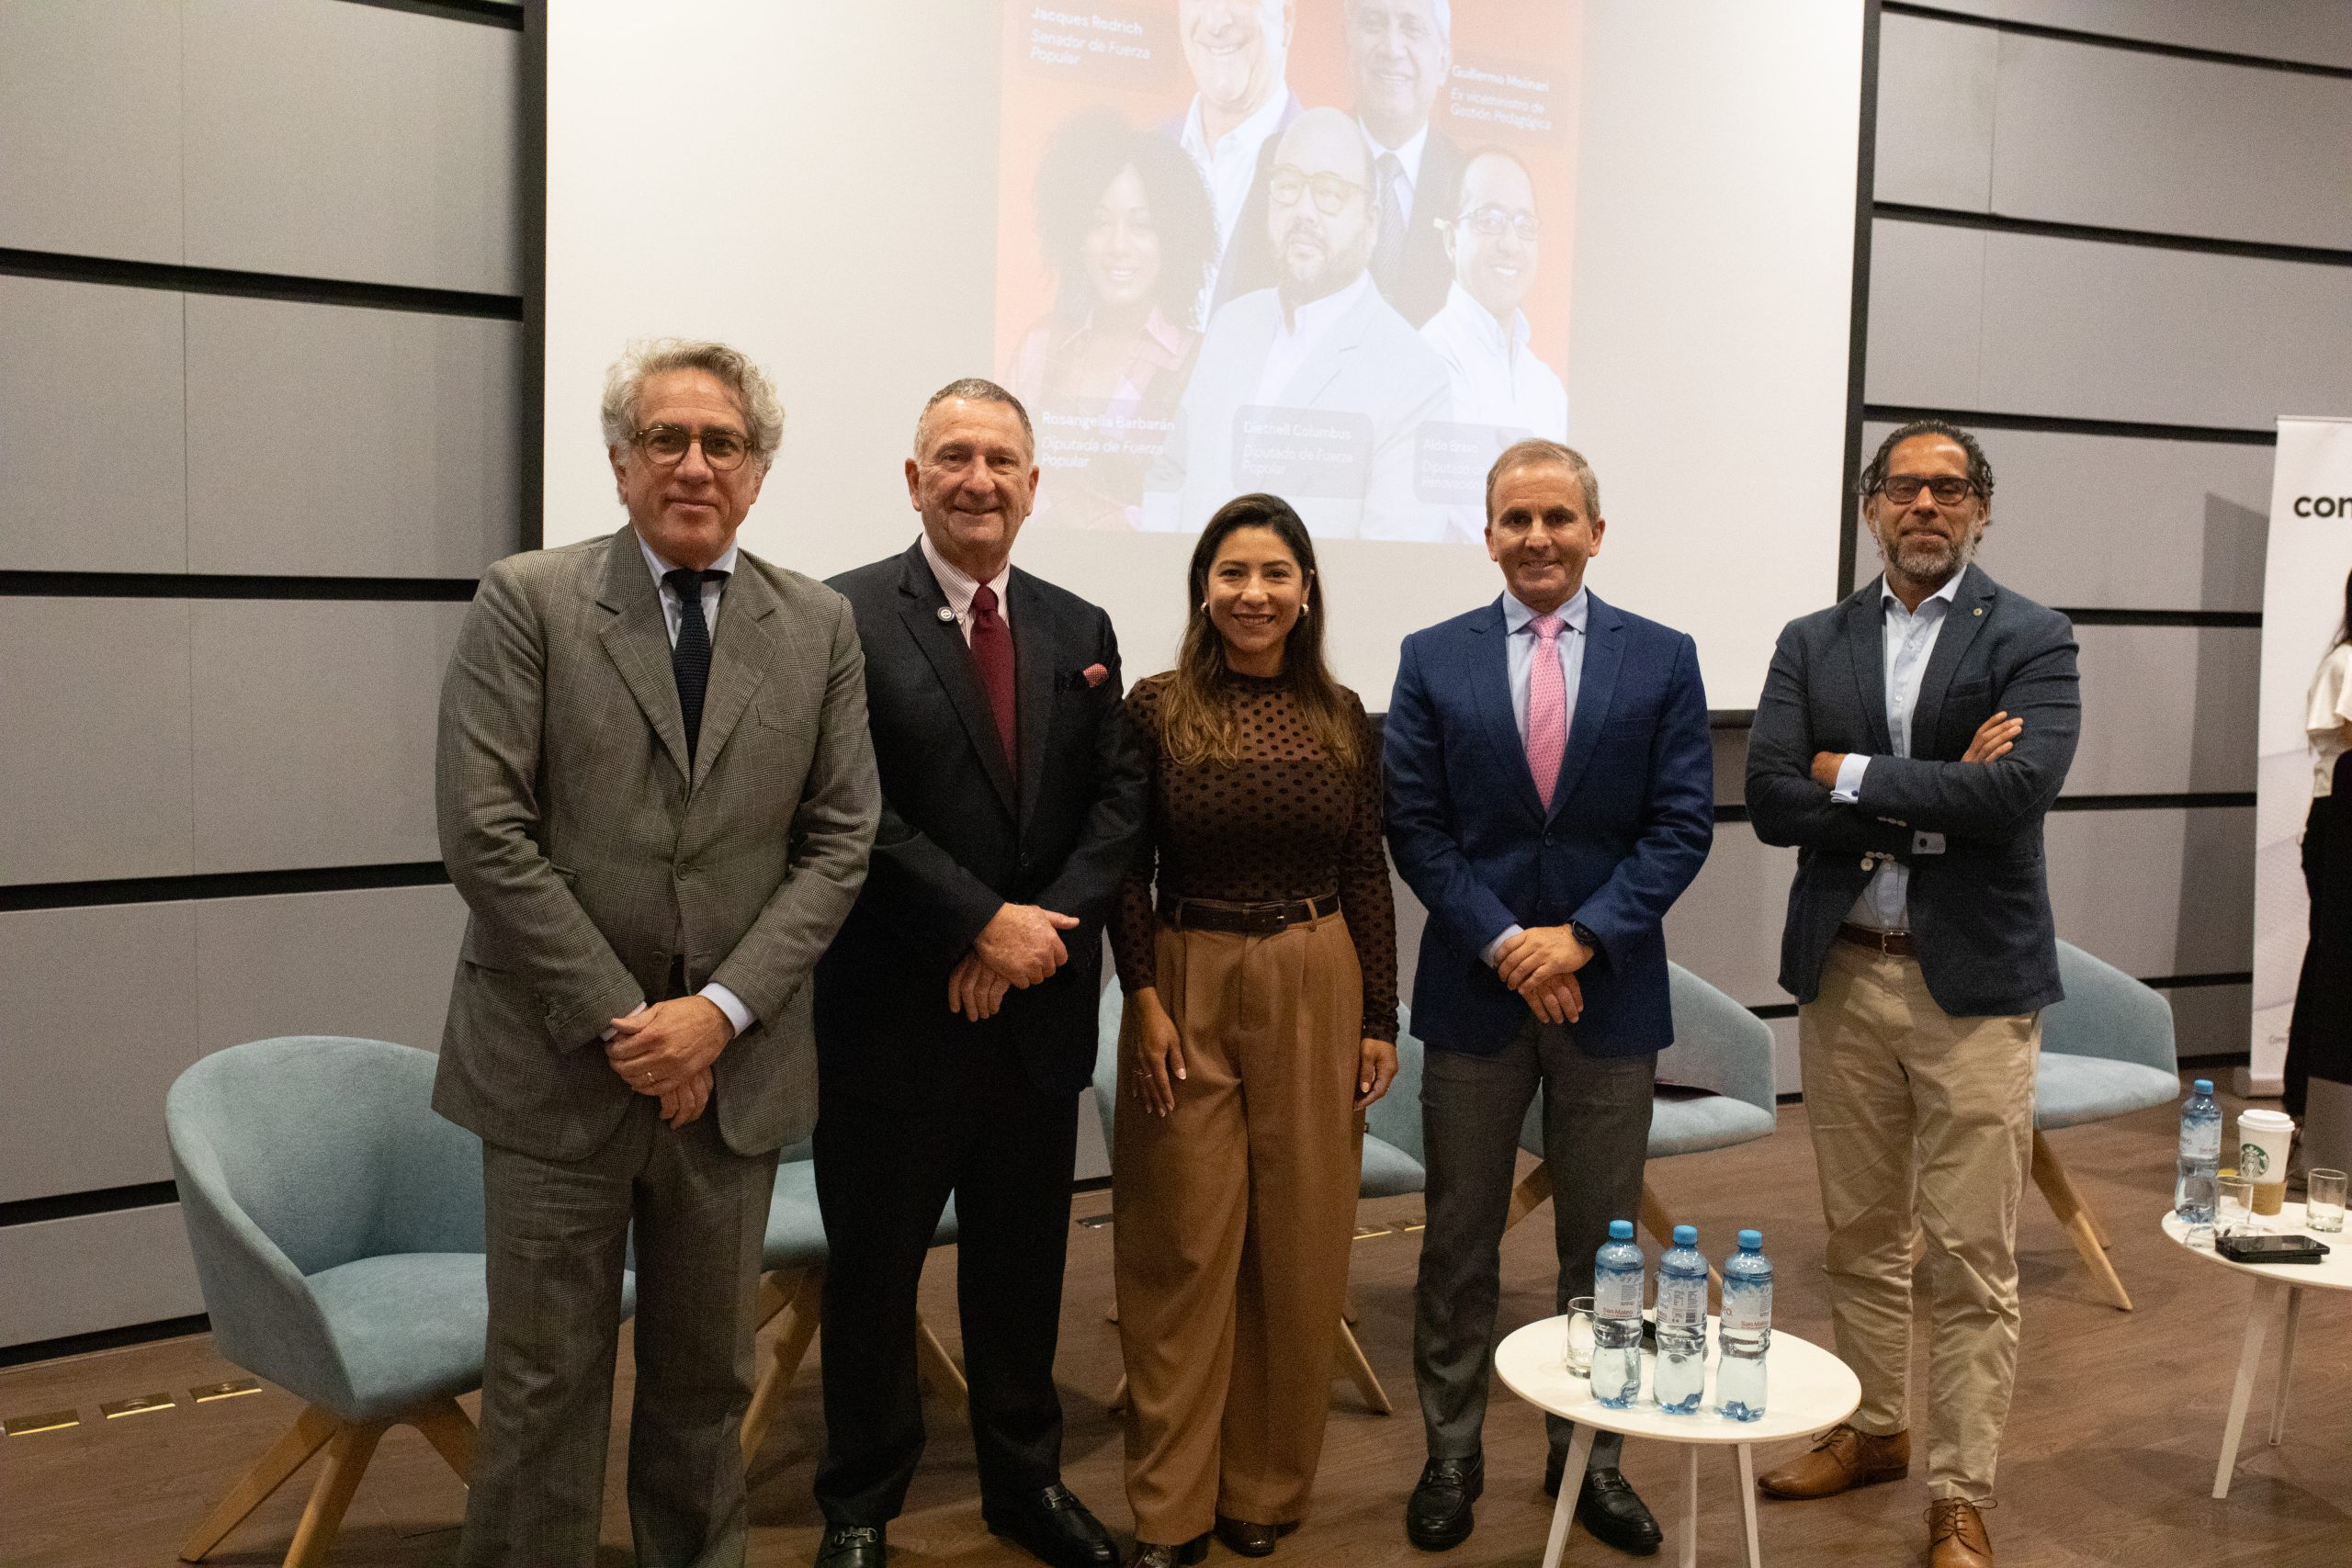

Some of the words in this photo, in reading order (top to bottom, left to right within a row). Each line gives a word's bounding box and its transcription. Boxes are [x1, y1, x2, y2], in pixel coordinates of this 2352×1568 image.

[1032, 6, 1090, 27] Jacques
[1091, 15, 1143, 35] Rodrich
[1031, 28, 1085, 49] Senador
[1088, 38, 1105, 52] de
[1108, 40, 1150, 60] Fuerza
[1030, 45, 1080, 64] Popular
[1531, 103, 1545, 114] de
[1115, 415, 1175, 431] Barbarán
[1293, 423, 1351, 440] Columbus
[1042, 435, 1100, 454] Diputada
[1103, 440, 1120, 453] de
[1122, 440, 1164, 455] Fuerza
[1243, 444, 1296, 462] Diputado
[1298, 447, 1315, 461] de
[1317, 448, 1353, 463] Fuerza
[1423, 438, 1448, 452] Aldo
[1450, 439, 1478, 454] Bravo
[1041, 453, 1090, 470] Popular
[1242, 459, 1286, 479] Popular
